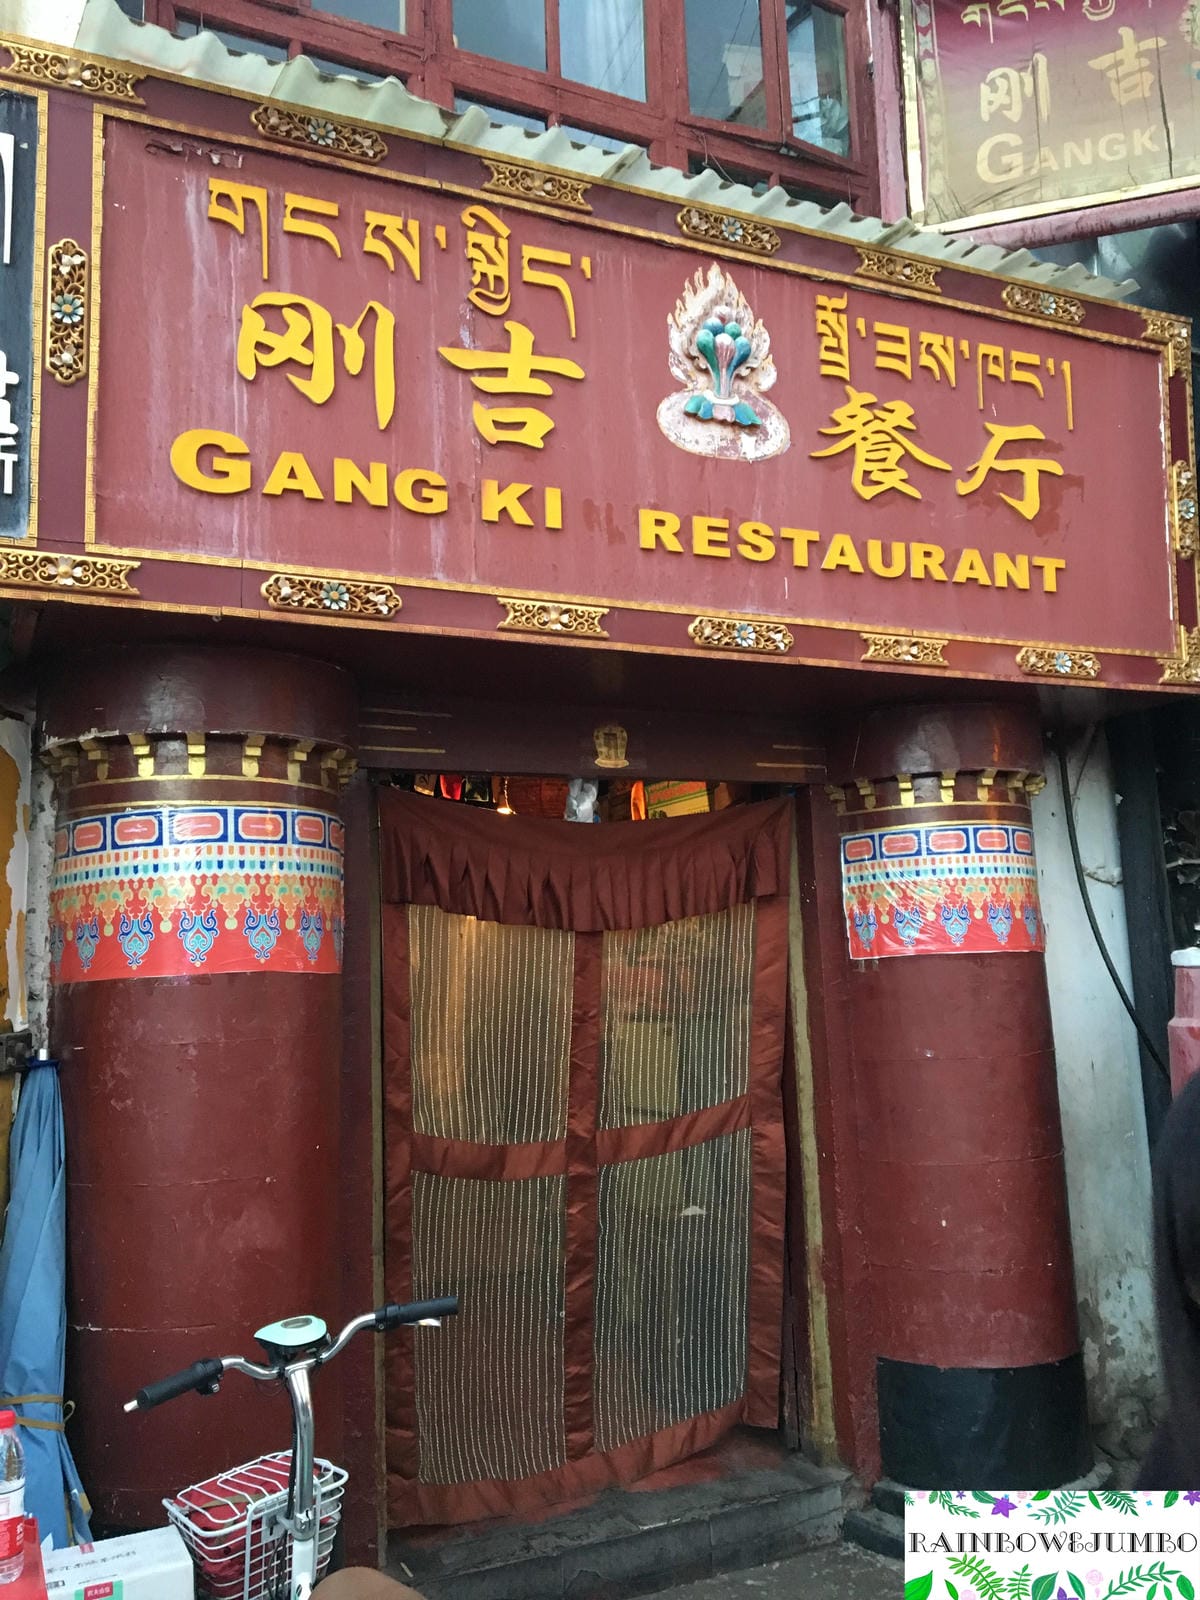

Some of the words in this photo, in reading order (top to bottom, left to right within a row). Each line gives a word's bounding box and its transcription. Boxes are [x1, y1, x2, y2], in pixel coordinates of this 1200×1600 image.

[979, 26, 1168, 123] 刚吉
[236, 291, 586, 449] 刚吉
[809, 385, 1066, 522] 餐厅
[170, 428, 449, 515] GANG
[481, 479, 563, 530] KI
[638, 508, 1066, 593] RESTAURANT
